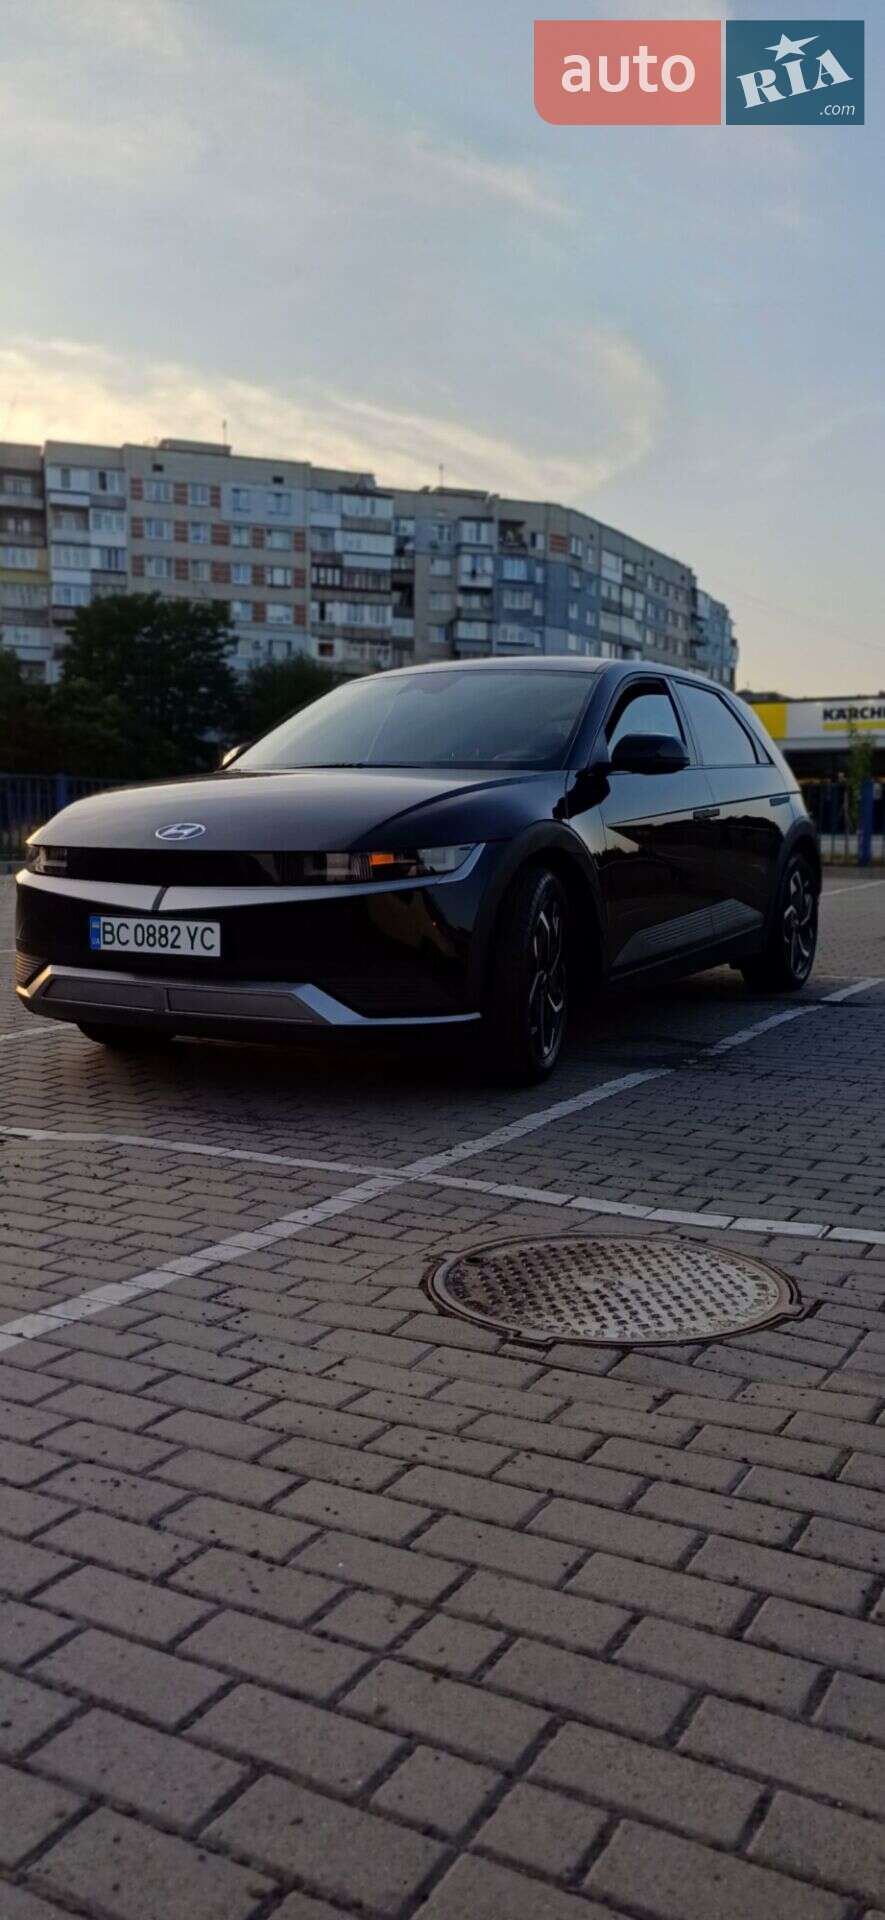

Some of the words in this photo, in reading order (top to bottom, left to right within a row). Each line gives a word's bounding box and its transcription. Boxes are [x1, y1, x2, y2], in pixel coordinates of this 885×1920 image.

[102, 922, 130, 945] BC
[134, 923, 181, 949] 0882
[187, 926, 215, 950] YC
